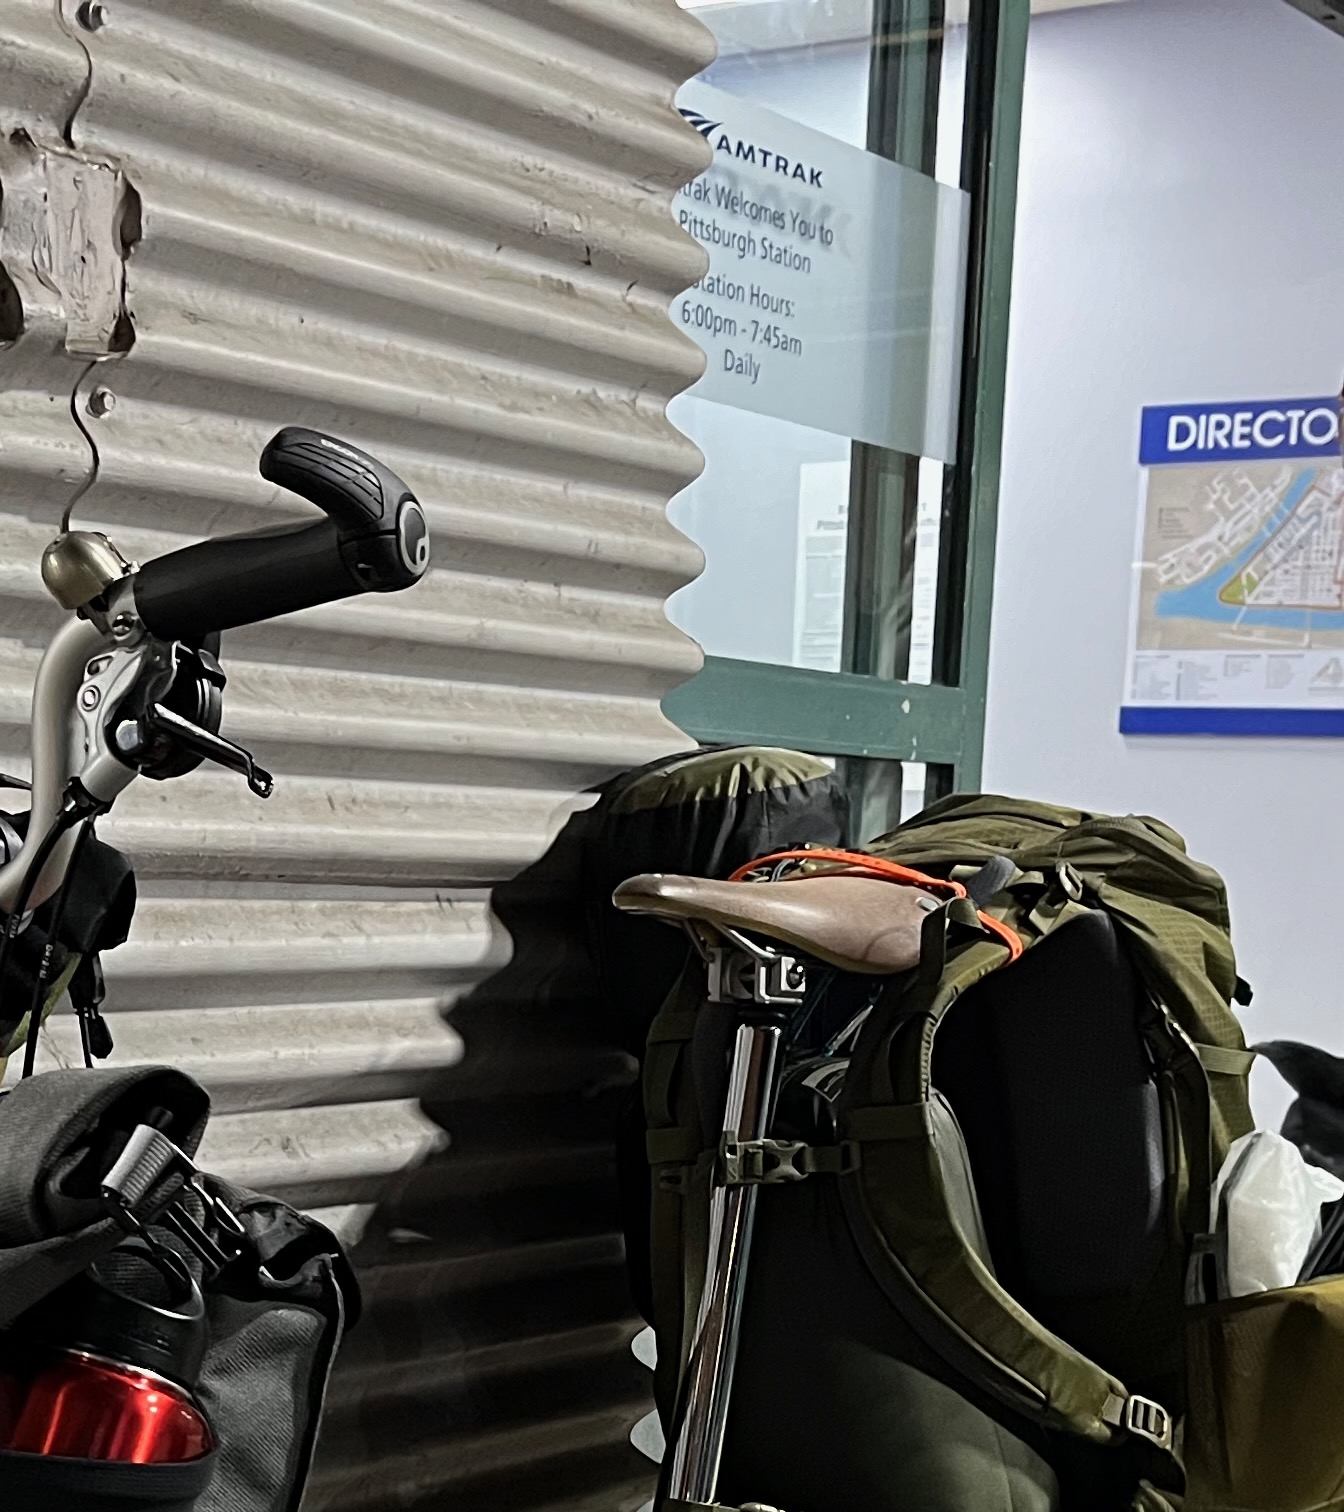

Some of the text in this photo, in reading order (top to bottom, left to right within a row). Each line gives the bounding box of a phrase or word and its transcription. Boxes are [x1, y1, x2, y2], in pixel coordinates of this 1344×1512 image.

[716, 134, 823, 189] AMTRAK
[678, 177, 834, 246] trak Welcomes You to
[679, 209, 811, 273] Pittsburgh Station
[681, 300, 737, 337] 6:00pm
[751, 319, 802, 357] 7:45am
[750, 283, 795, 318] Hours:
[724, 349, 761, 385] Daily
